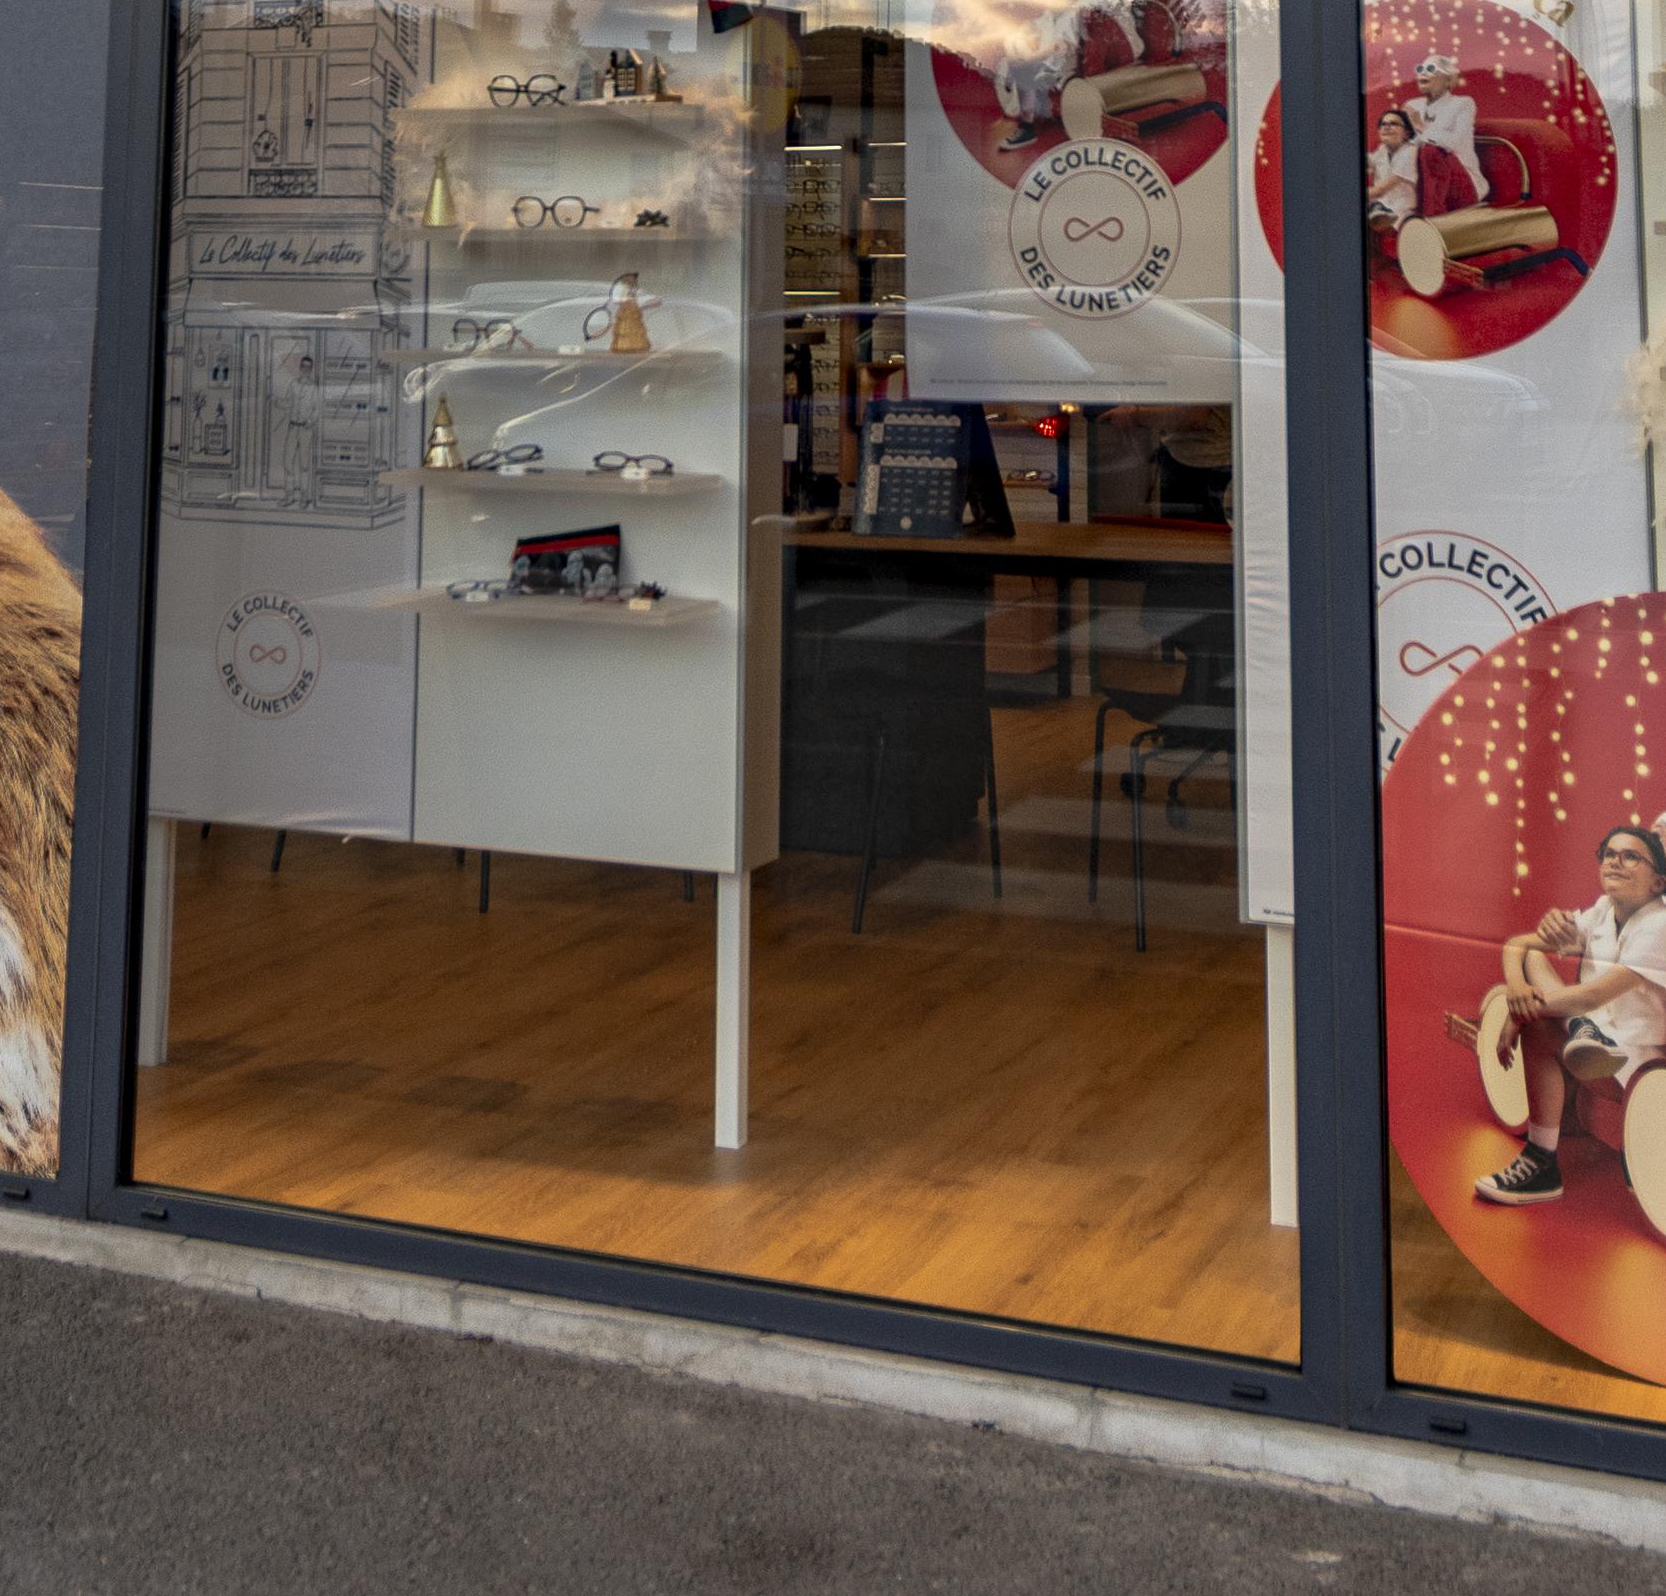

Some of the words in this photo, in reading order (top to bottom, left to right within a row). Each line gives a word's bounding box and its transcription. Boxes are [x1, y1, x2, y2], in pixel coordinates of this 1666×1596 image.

[1024, 172, 1052, 202] LE
[1051, 147, 1167, 201] COLLECTIF
[1020, 246, 1055, 291] DES
[1055, 245, 1171, 312] LUNETIERS
[1379, 541, 1548, 624] COLLECTIF
[226, 609, 244, 632] LE
[243, 596, 313, 638] COLLECTIF
[222, 664, 242, 696] DES
[242, 670, 314, 713] LUNETIERS
